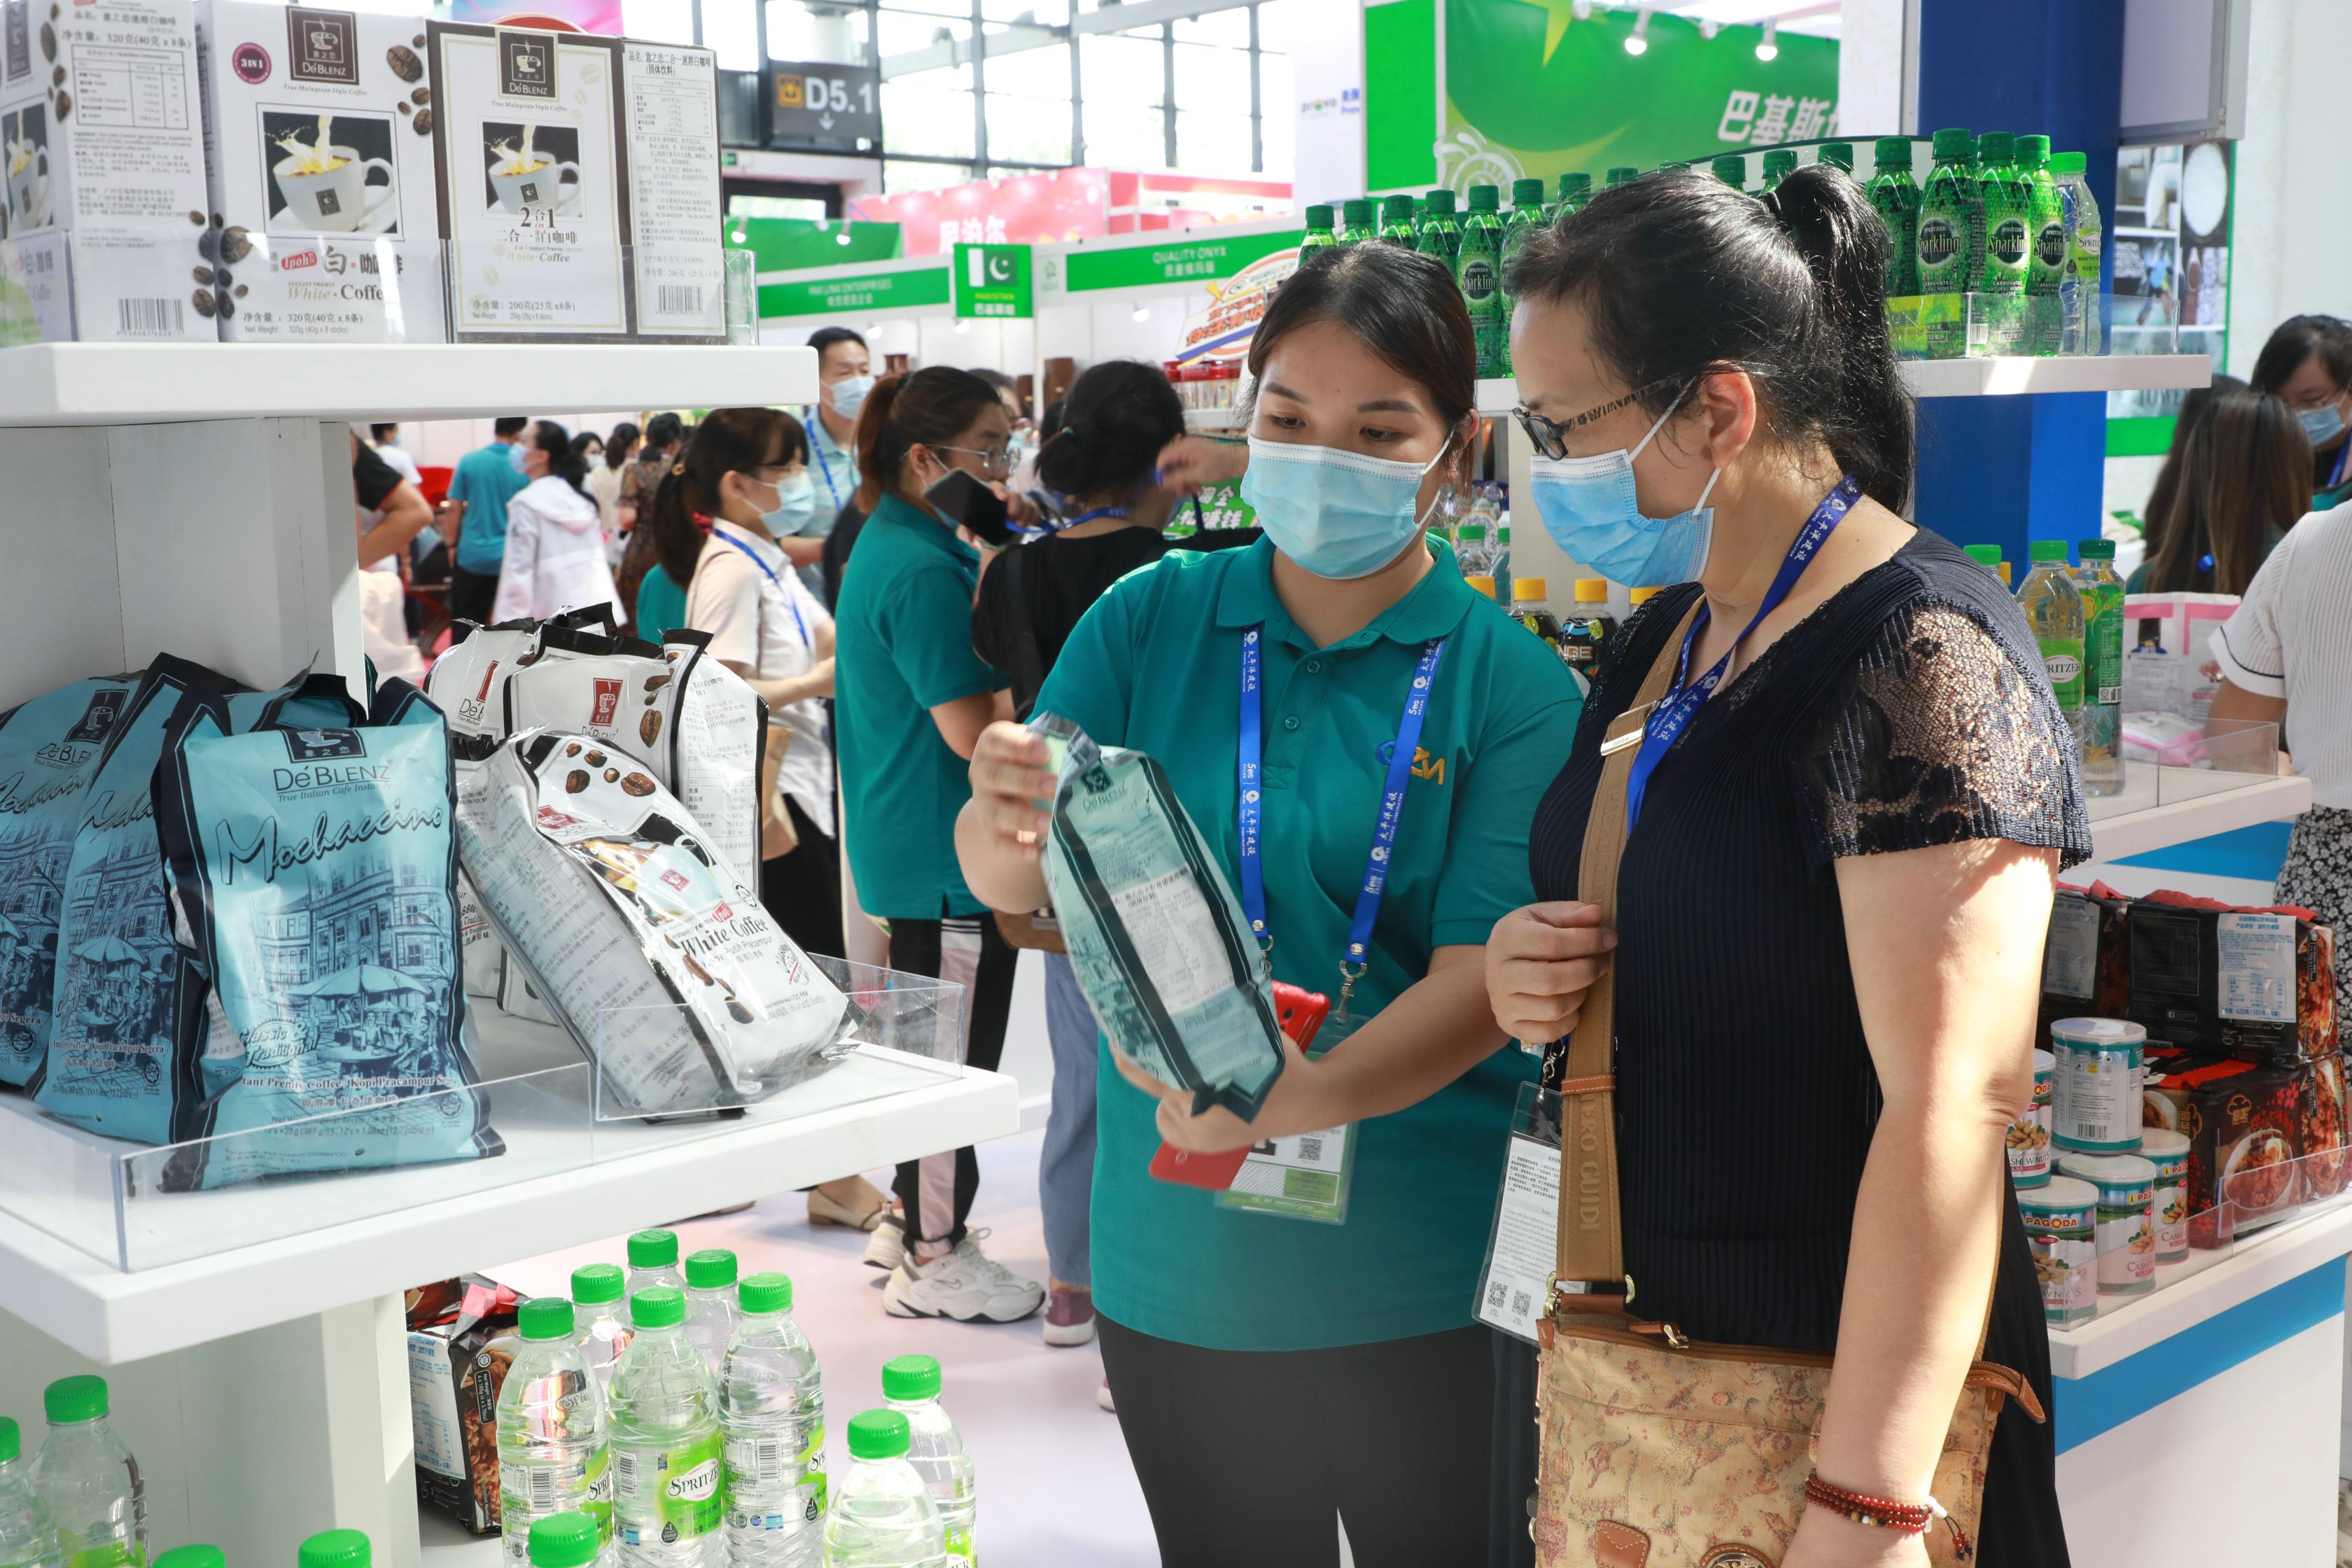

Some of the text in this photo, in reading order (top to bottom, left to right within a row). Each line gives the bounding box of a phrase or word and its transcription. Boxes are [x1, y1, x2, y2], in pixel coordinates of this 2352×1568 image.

[806, 76, 873, 114] D5.1
[1153, 249, 1195, 265] QUALITY
[1793, 511, 1834, 561] 太平洋建设
[1420, 638, 1436, 673] 太平洋建
[1557, 644, 1592, 661] NGE
[1247, 650, 1257, 692] 太平洋建设
[2045, 663, 2081, 674] RITZER
[1656, 692, 1700, 741] 太平洋建设
[277, 792, 298, 803] True
[300, 790, 330, 800] Italian
[1378, 790, 1399, 841] 太平洋建设
[1246, 808, 1257, 857] 太平洋建设
[730, 915, 769, 937] Coffee
[10, 1014, 41, 1025] Segera
[140, 1044, 164, 1054] Segera
[267, 1078, 304, 1089] Premix
[351, 1077, 376, 1089] Kopi
[379, 1077, 435, 1088] Pracampur
[1579, 1093, 1601, 1231] IERO GUIDI
[2010, 1157, 2032, 1167] SHEW
[2026, 1216, 2079, 1229] PAGODA
[668, 1464, 720, 1497] SPRITZE
